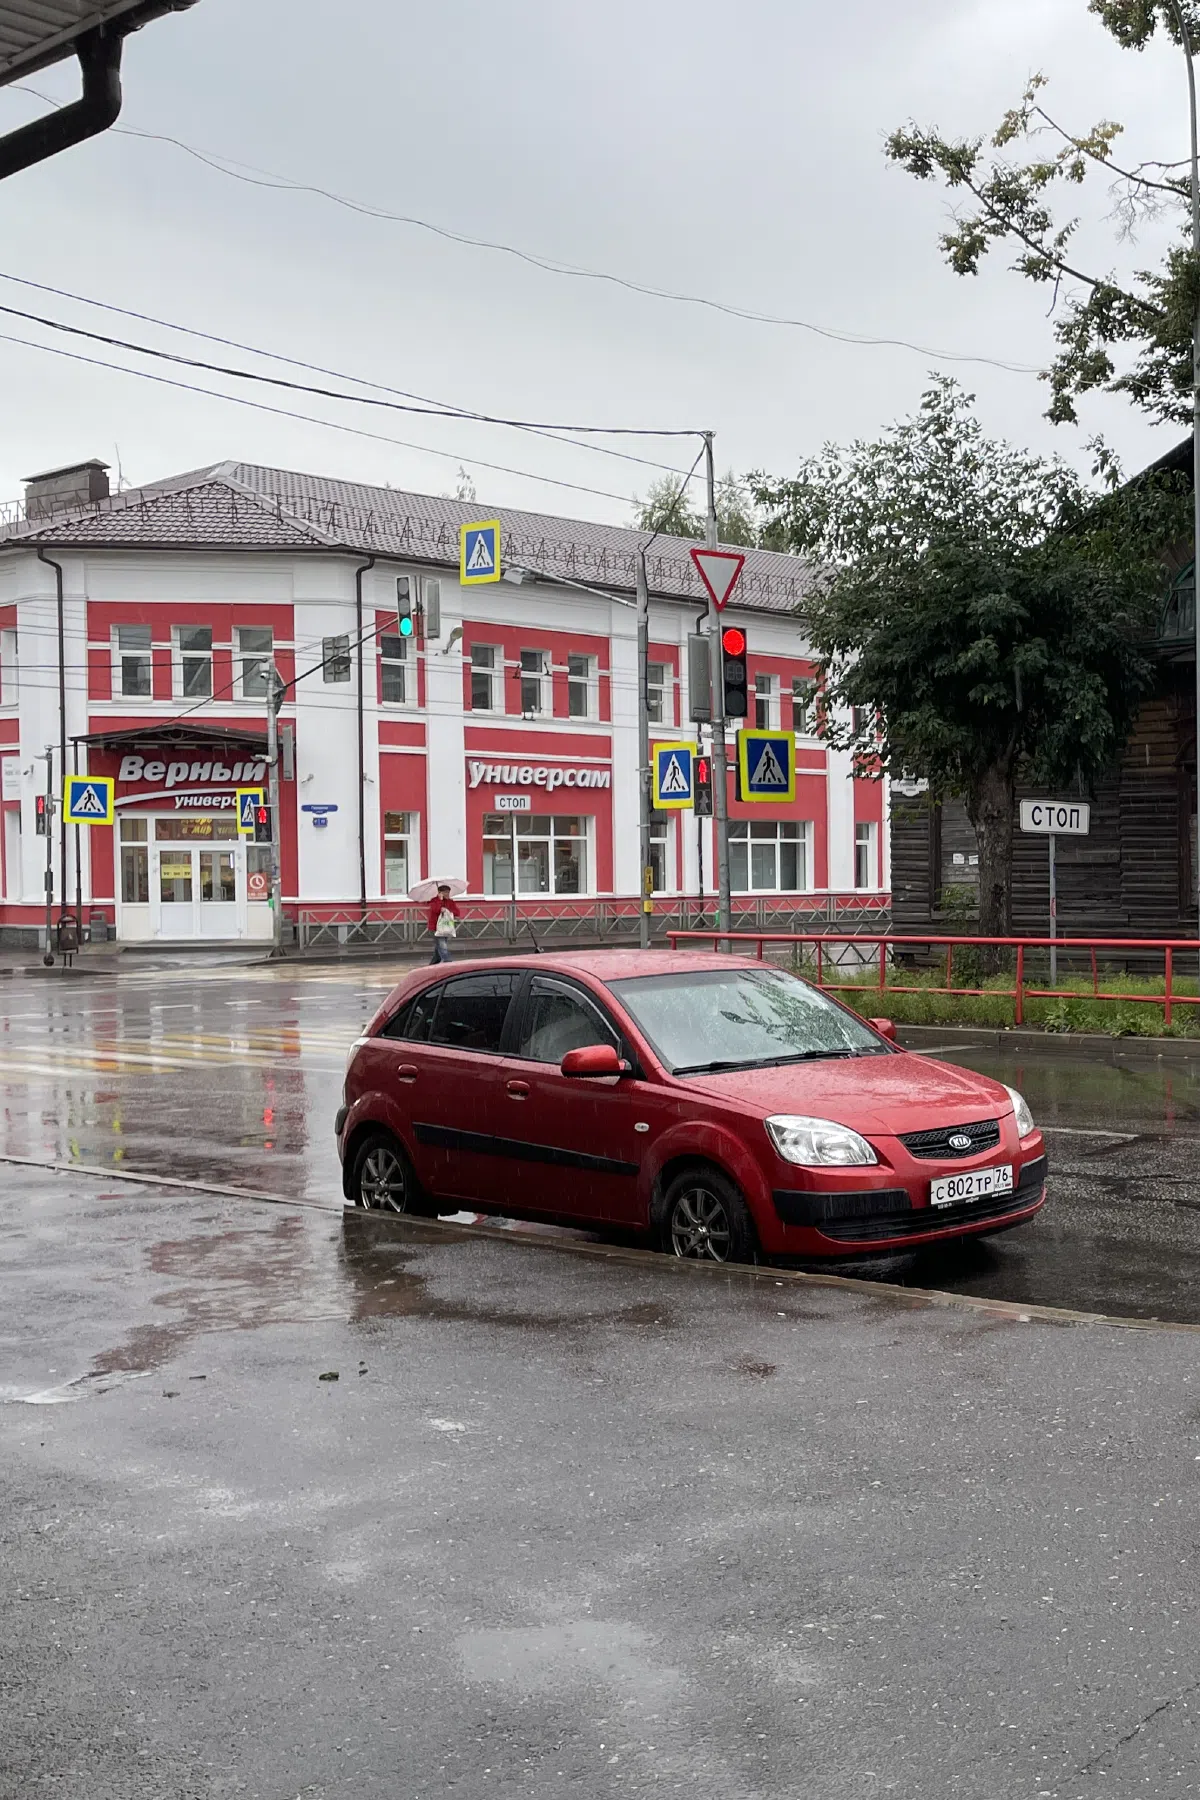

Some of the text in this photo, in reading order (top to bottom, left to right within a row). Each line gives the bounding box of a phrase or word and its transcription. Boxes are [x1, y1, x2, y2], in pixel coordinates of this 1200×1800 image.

[118, 755, 267, 788] Верный
[468, 760, 611, 792] универсам
[174, 793, 237, 809] универс
[499, 797, 527, 809] СТОП
[1031, 805, 1080, 829] СТОП
[951, 1136, 970, 1148] KIA
[995, 1168, 1009, 1184] 76
